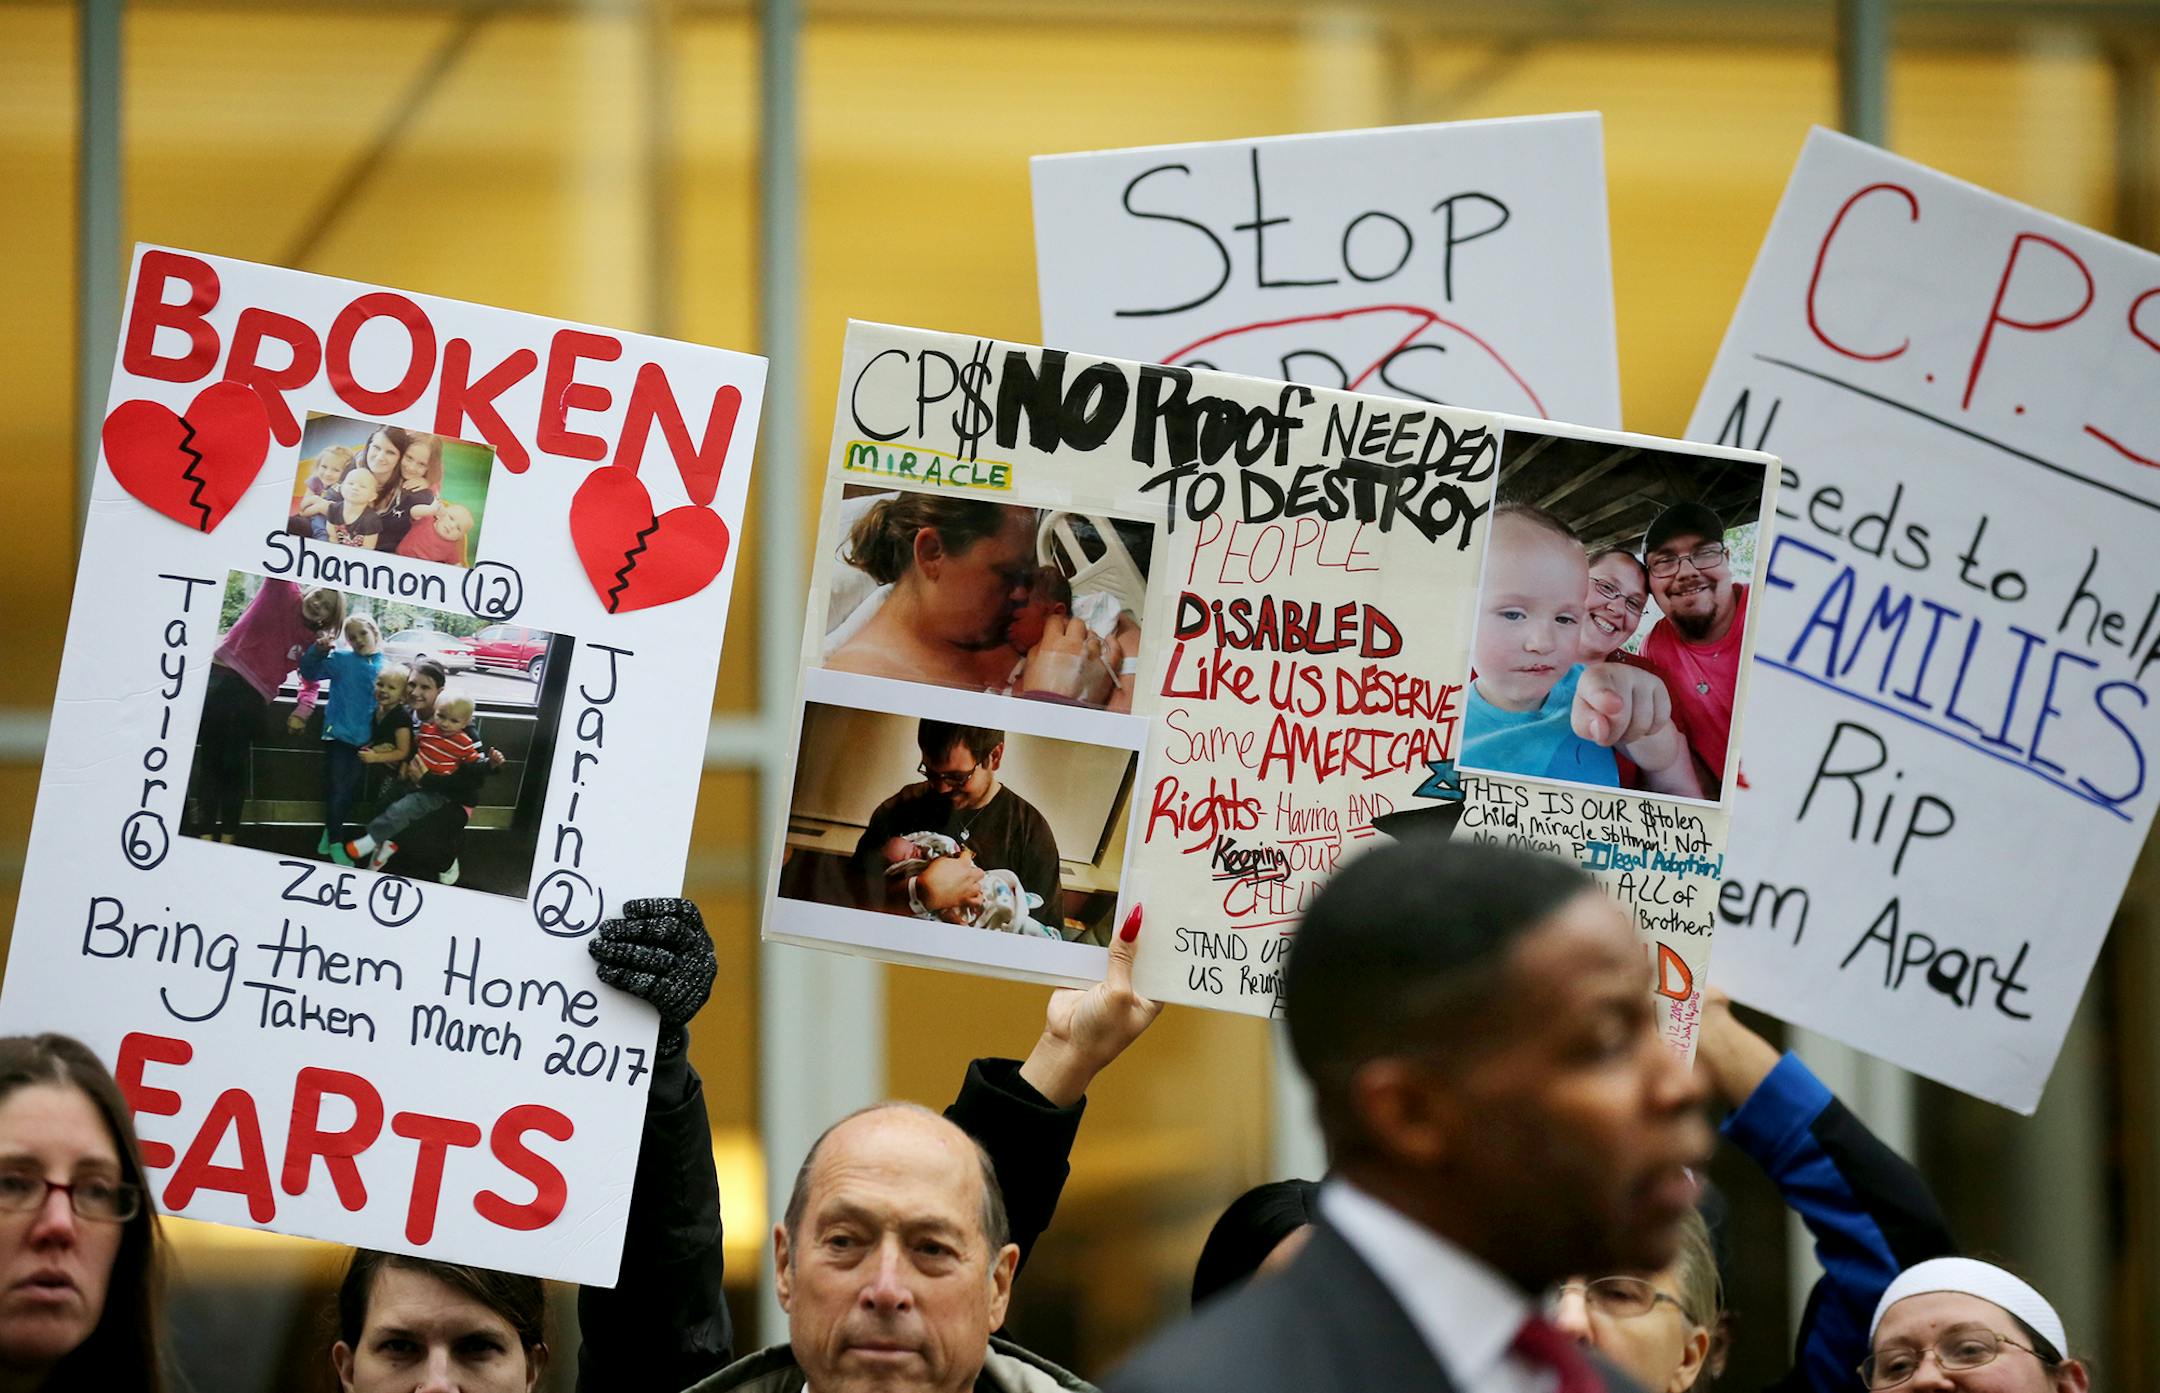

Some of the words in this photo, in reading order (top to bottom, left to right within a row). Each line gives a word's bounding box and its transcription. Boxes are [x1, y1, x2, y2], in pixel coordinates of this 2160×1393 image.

[122, 249, 743, 507] BROKEN
[852, 340, 994, 462] CP$
[996, 349, 1130, 454] NO
[1322, 401, 1498, 482] NEEDED
[1139, 462, 1226, 534] TO
[1240, 457, 1491, 551] DESTROY
[262, 530, 446, 603] Shannon
[1188, 512, 1380, 585] PEOPLE
[1957, 514, 2028, 601] to
[1160, 642, 1260, 705] Like
[1269, 660, 1327, 718] US
[1336, 663, 1463, 723] DESERVE
[1764, 534, 2149, 808] FAMILIES
[1165, 708, 1260, 769] Same
[1257, 713, 1459, 784] AMERICAN
[1276, 791, 1343, 845] Having
[1348, 793, 1394, 826] AND
[1460, 777, 1529, 808] THIS
[1538, 791, 1574, 815] IS
[1581, 798, 1632, 823] OUR
[1797, 721, 1957, 877] Rip
[1211, 834, 1292, 882] Keeping
[1290, 841, 1344, 875] OUR
[1675, 831, 1713, 854] Not
[1617, 872, 1670, 905] ALL
[1672, 884, 1698, 908] of
[1639, 908, 1714, 937] Brother!
[1718, 879, 1810, 946] em
[82, 897, 240, 1022] Bring
[257, 918, 402, 991] them
[443, 936, 600, 1028] Home
[1174, 927, 1248, 961] STAND
[1261, 937, 1292, 963] UP
[1188, 964, 1223, 995] US
[243, 980, 376, 1041] Taken
[544, 1033, 650, 1086] 2017
[114, 1031, 575, 1246] EARTS
